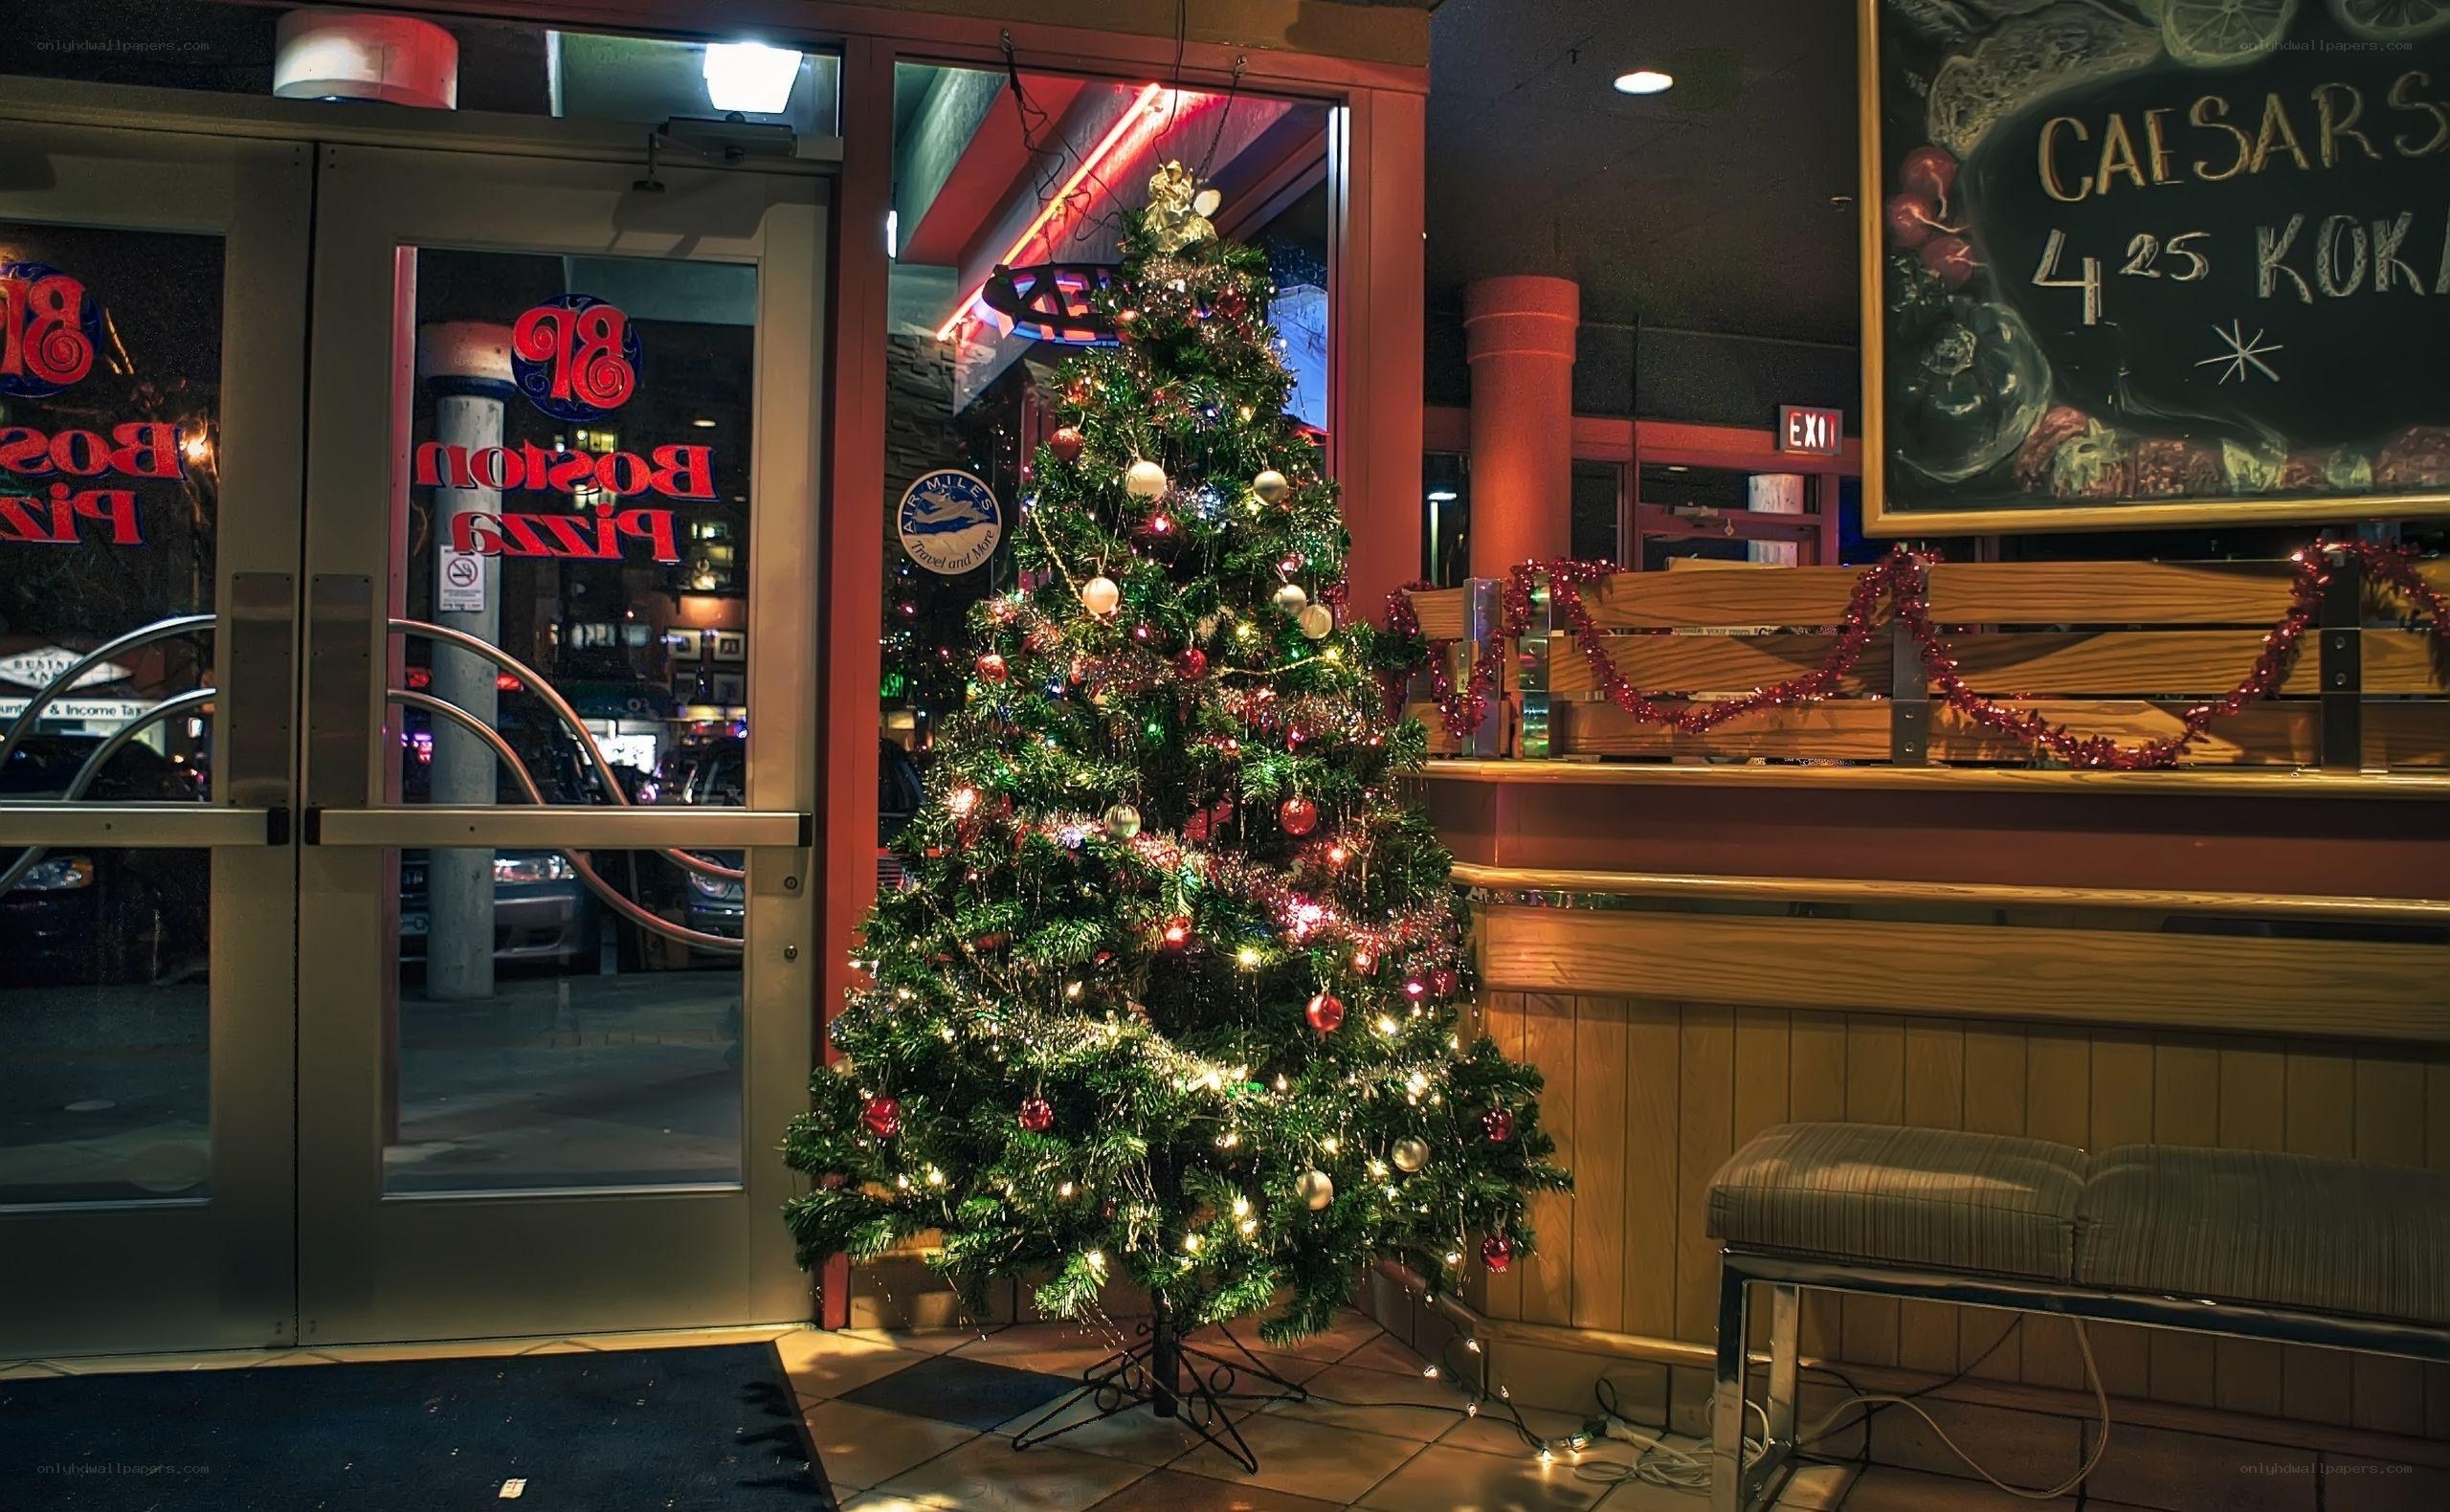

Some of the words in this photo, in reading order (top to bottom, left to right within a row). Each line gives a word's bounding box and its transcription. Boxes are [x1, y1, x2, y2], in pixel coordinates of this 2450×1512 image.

[2038, 71, 2450, 202] CAESARS
[1788, 411, 1837, 451] EXIT
[902, 493, 921, 534] AIR
[925, 475, 993, 511] MILES
[911, 540, 947, 569] Travel
[948, 553, 971, 569] and
[971, 529, 995, 561] More
[65, 704, 117, 716] Income
